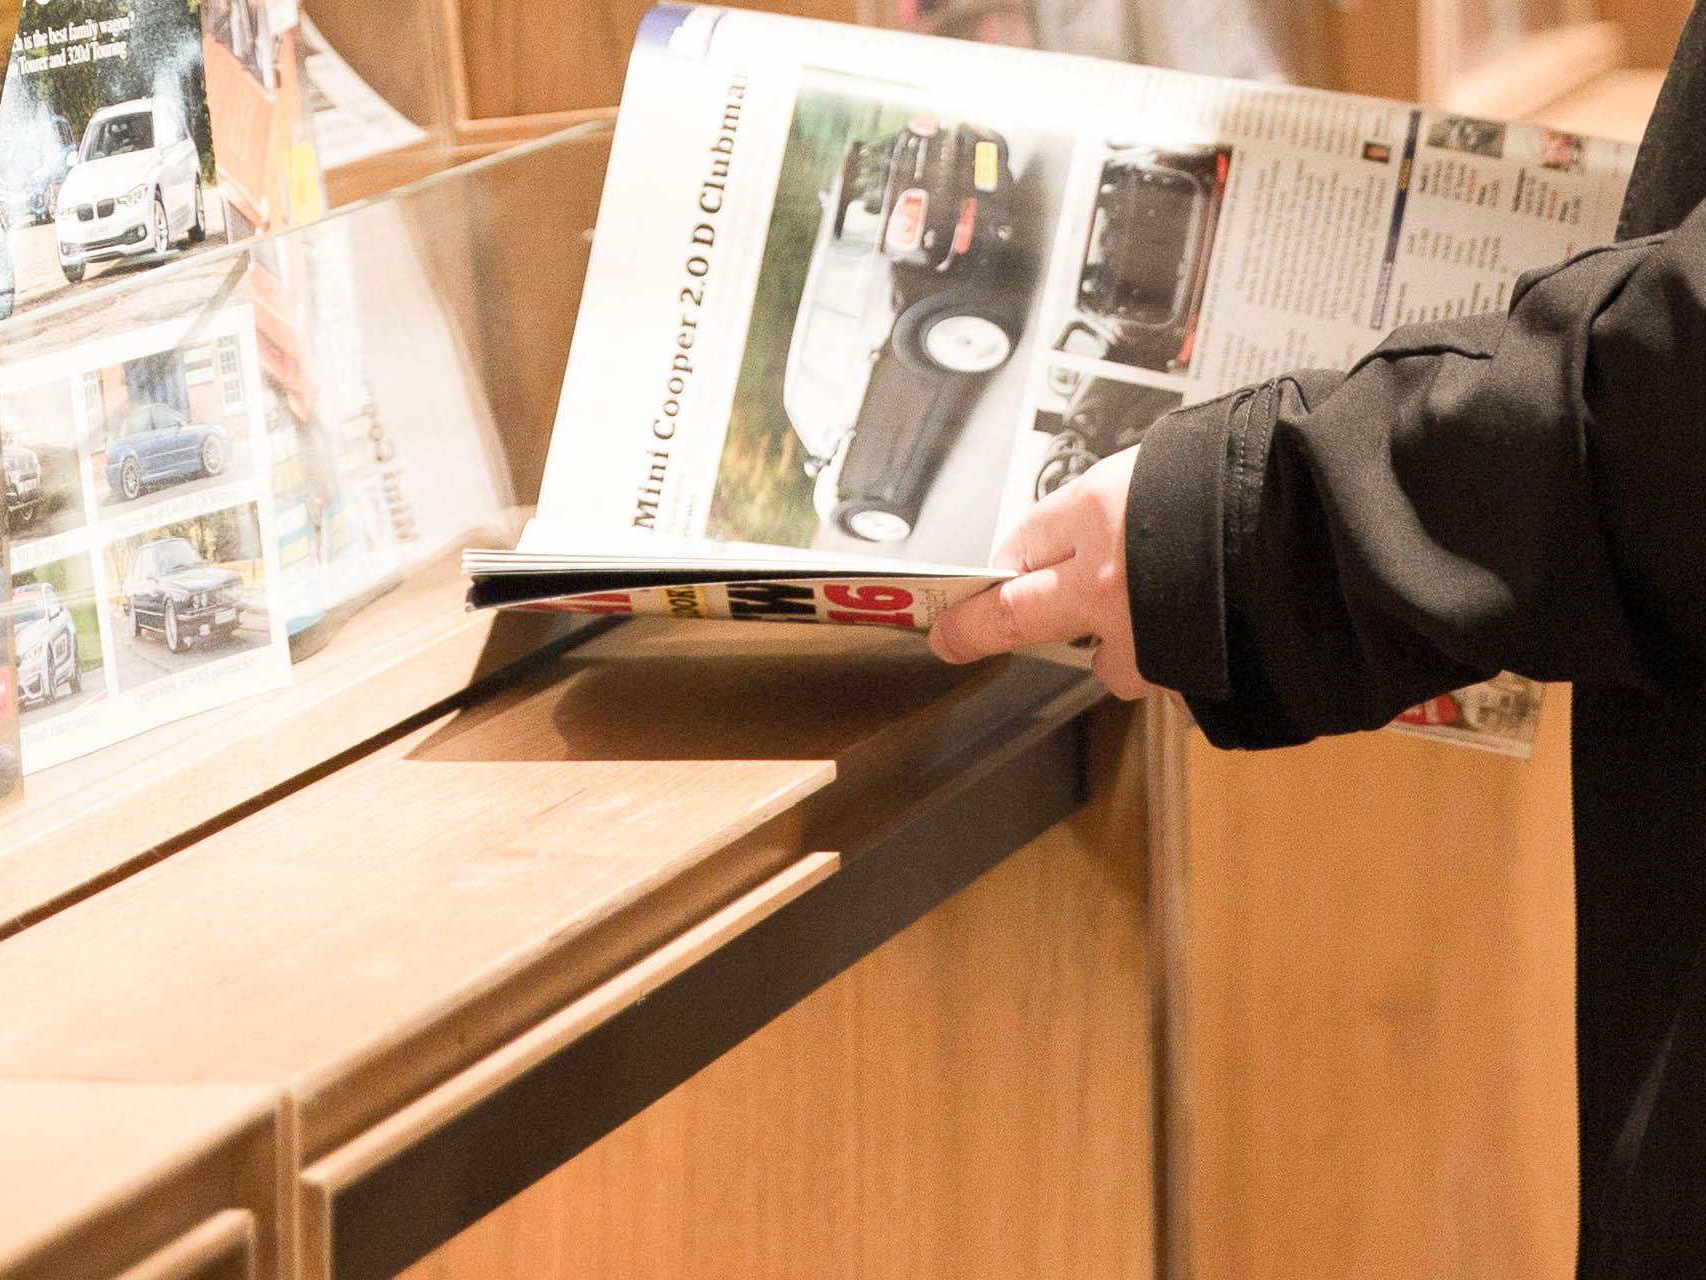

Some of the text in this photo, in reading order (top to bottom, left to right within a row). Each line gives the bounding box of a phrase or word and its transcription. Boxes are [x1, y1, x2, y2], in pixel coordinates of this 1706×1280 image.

[48, 26, 68, 46] best
[68, 18, 98, 41] family
[49, 48, 67, 67] and
[692, 223, 717, 248] D
[679, 255, 710, 308] 2.0
[653, 312, 698, 441] Cooper
[632, 447, 670, 530] Mini
